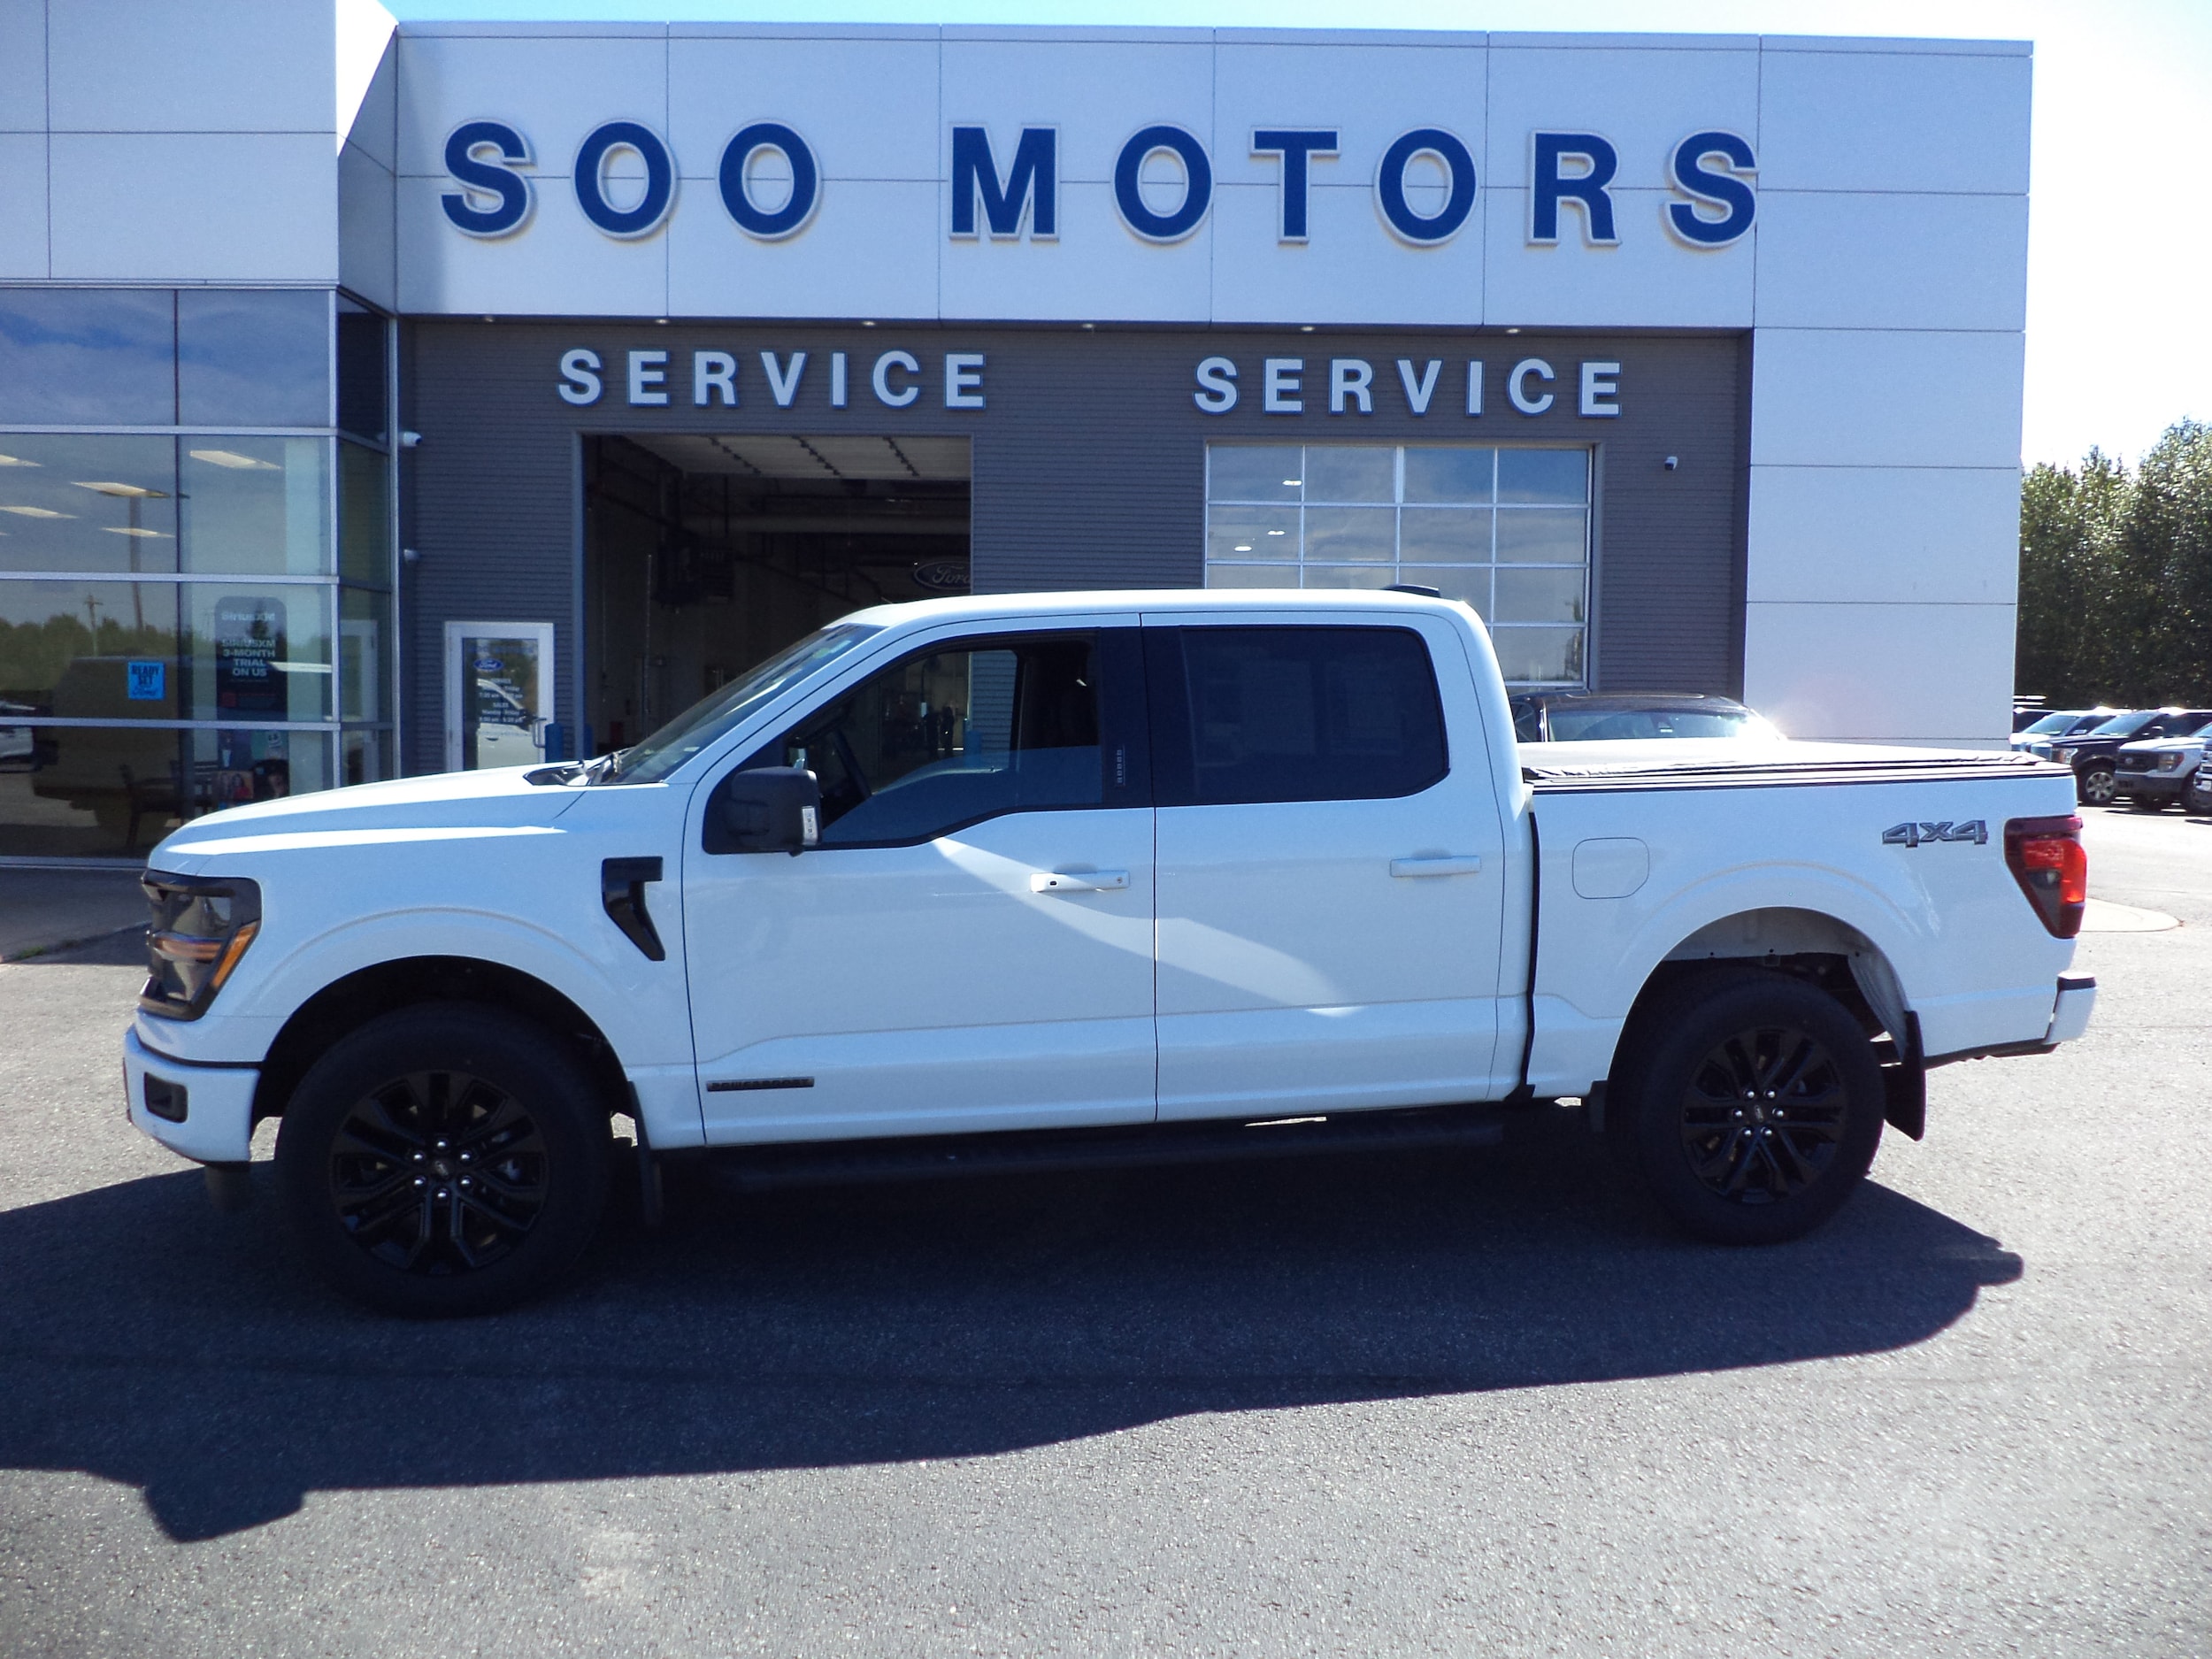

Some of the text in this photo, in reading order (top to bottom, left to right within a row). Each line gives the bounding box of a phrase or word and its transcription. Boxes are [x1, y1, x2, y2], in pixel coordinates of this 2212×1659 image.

[441, 119, 1757, 246] SOO MOTORS
[557, 349, 986, 408] SERVICE
[1193, 356, 1622, 417] SERVICE
[222, 639, 276, 648] SIRIUSXM
[222, 649, 276, 657] 3-MONTH
[233, 658, 266, 667] TRIAL
[131, 664, 159, 675] READY
[232, 667, 268, 677] ON US
[138, 674, 153, 686] SET
